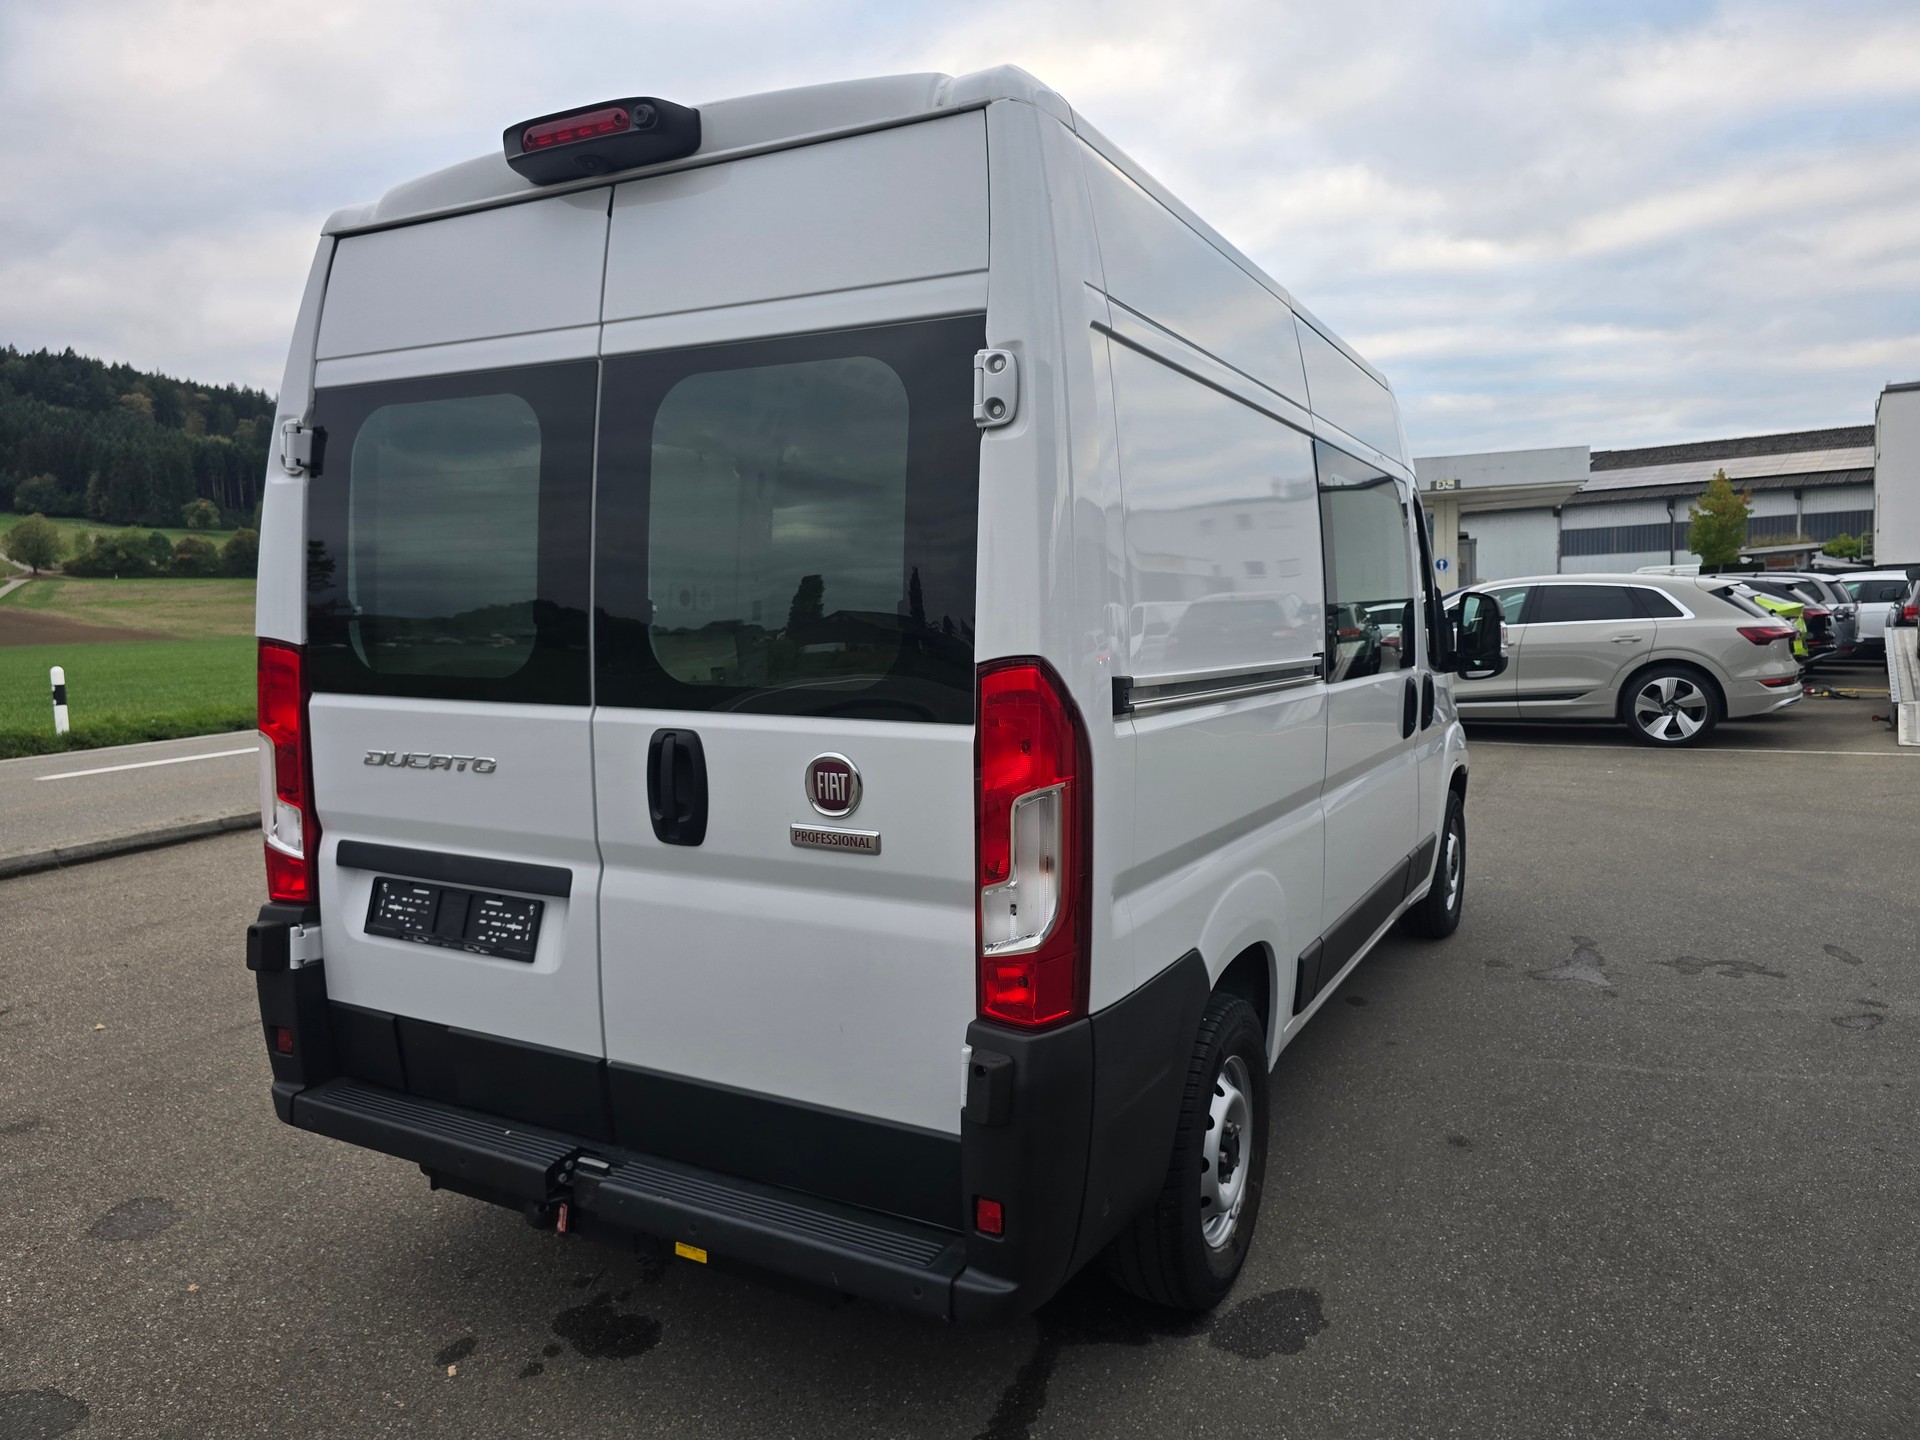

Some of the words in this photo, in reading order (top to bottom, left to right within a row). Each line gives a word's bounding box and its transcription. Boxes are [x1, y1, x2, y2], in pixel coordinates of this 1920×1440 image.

[363, 749, 497, 774] DUCATO
[817, 771, 848, 801] FIAT
[794, 830, 872, 849] PROFESSIONAL
